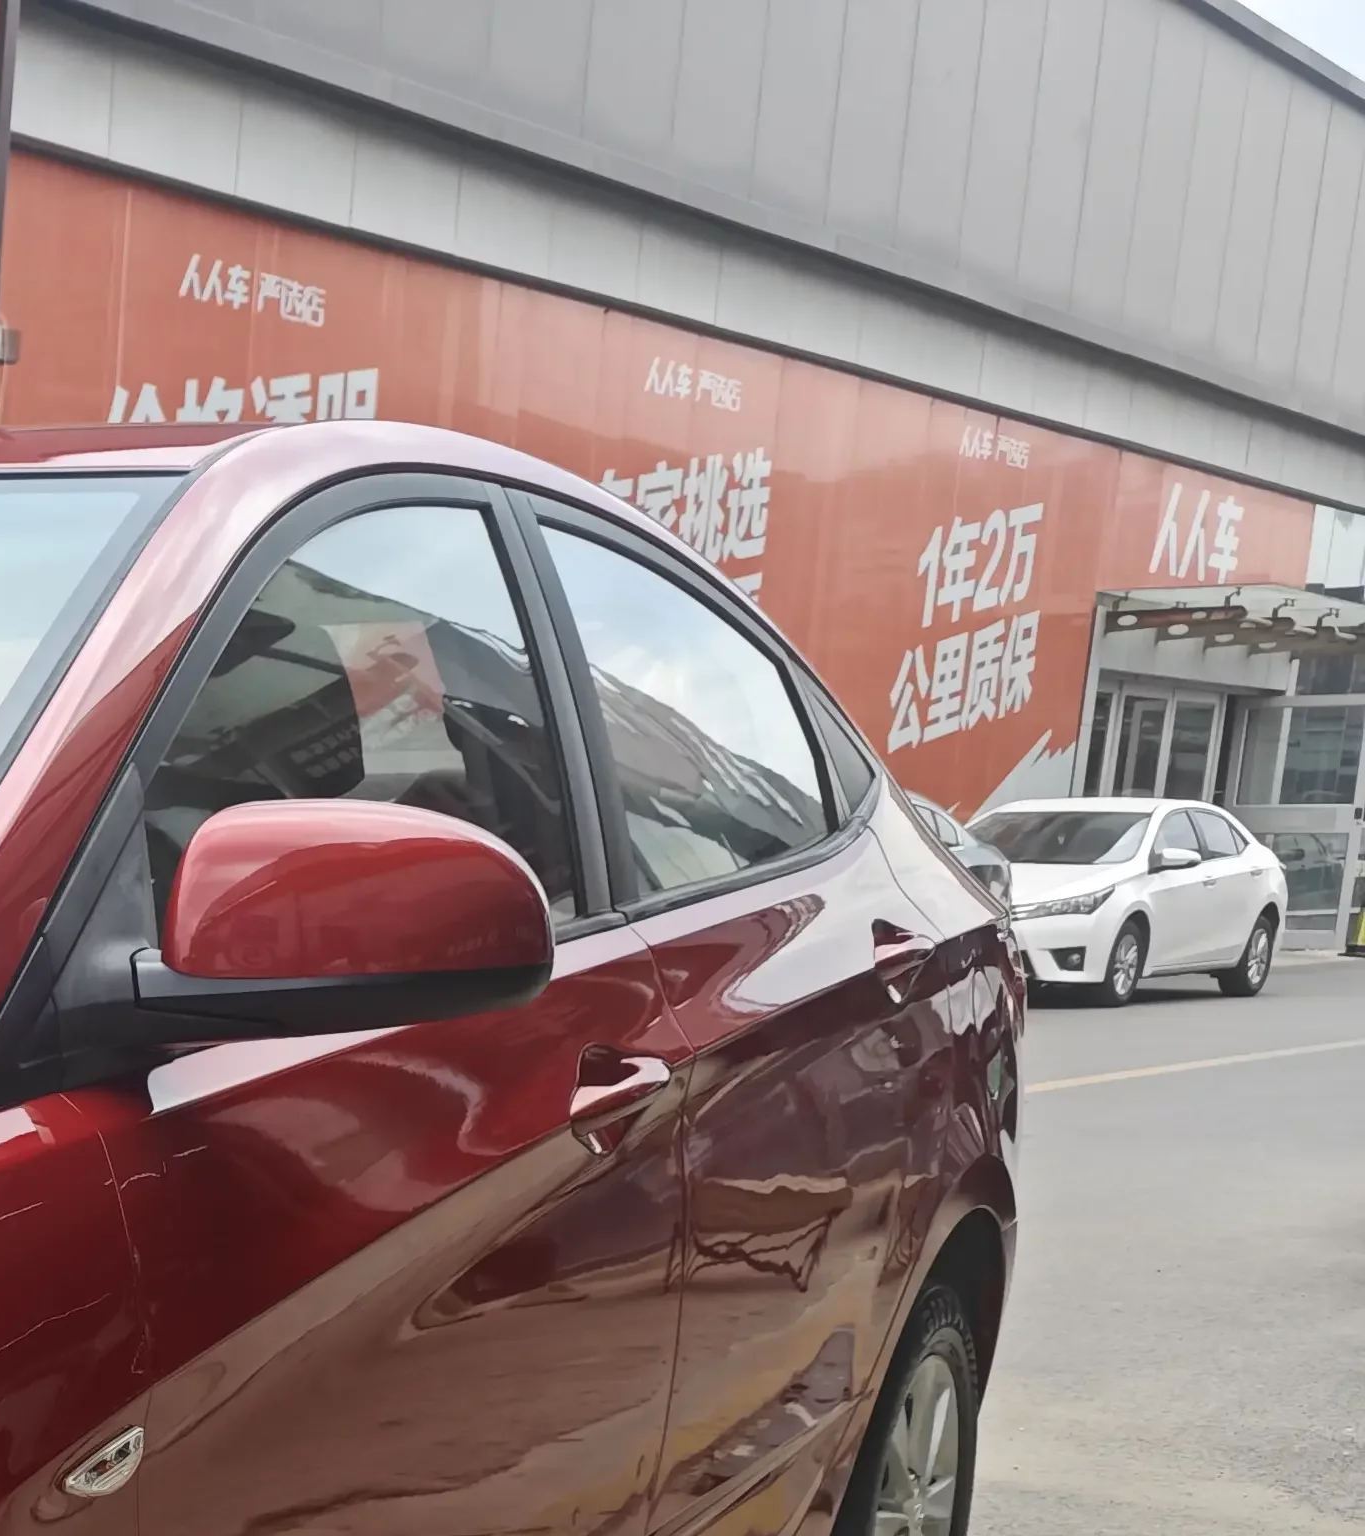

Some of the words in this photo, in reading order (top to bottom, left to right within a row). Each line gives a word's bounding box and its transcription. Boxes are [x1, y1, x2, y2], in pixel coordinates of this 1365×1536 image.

[178, 253, 252, 310] 人人车
[644, 356, 693, 401] 人人车
[917, 502, 1045, 629] 1年2万
[1148, 482, 1245, 585] 人人车
[887, 609, 1041, 755] 公里质保
